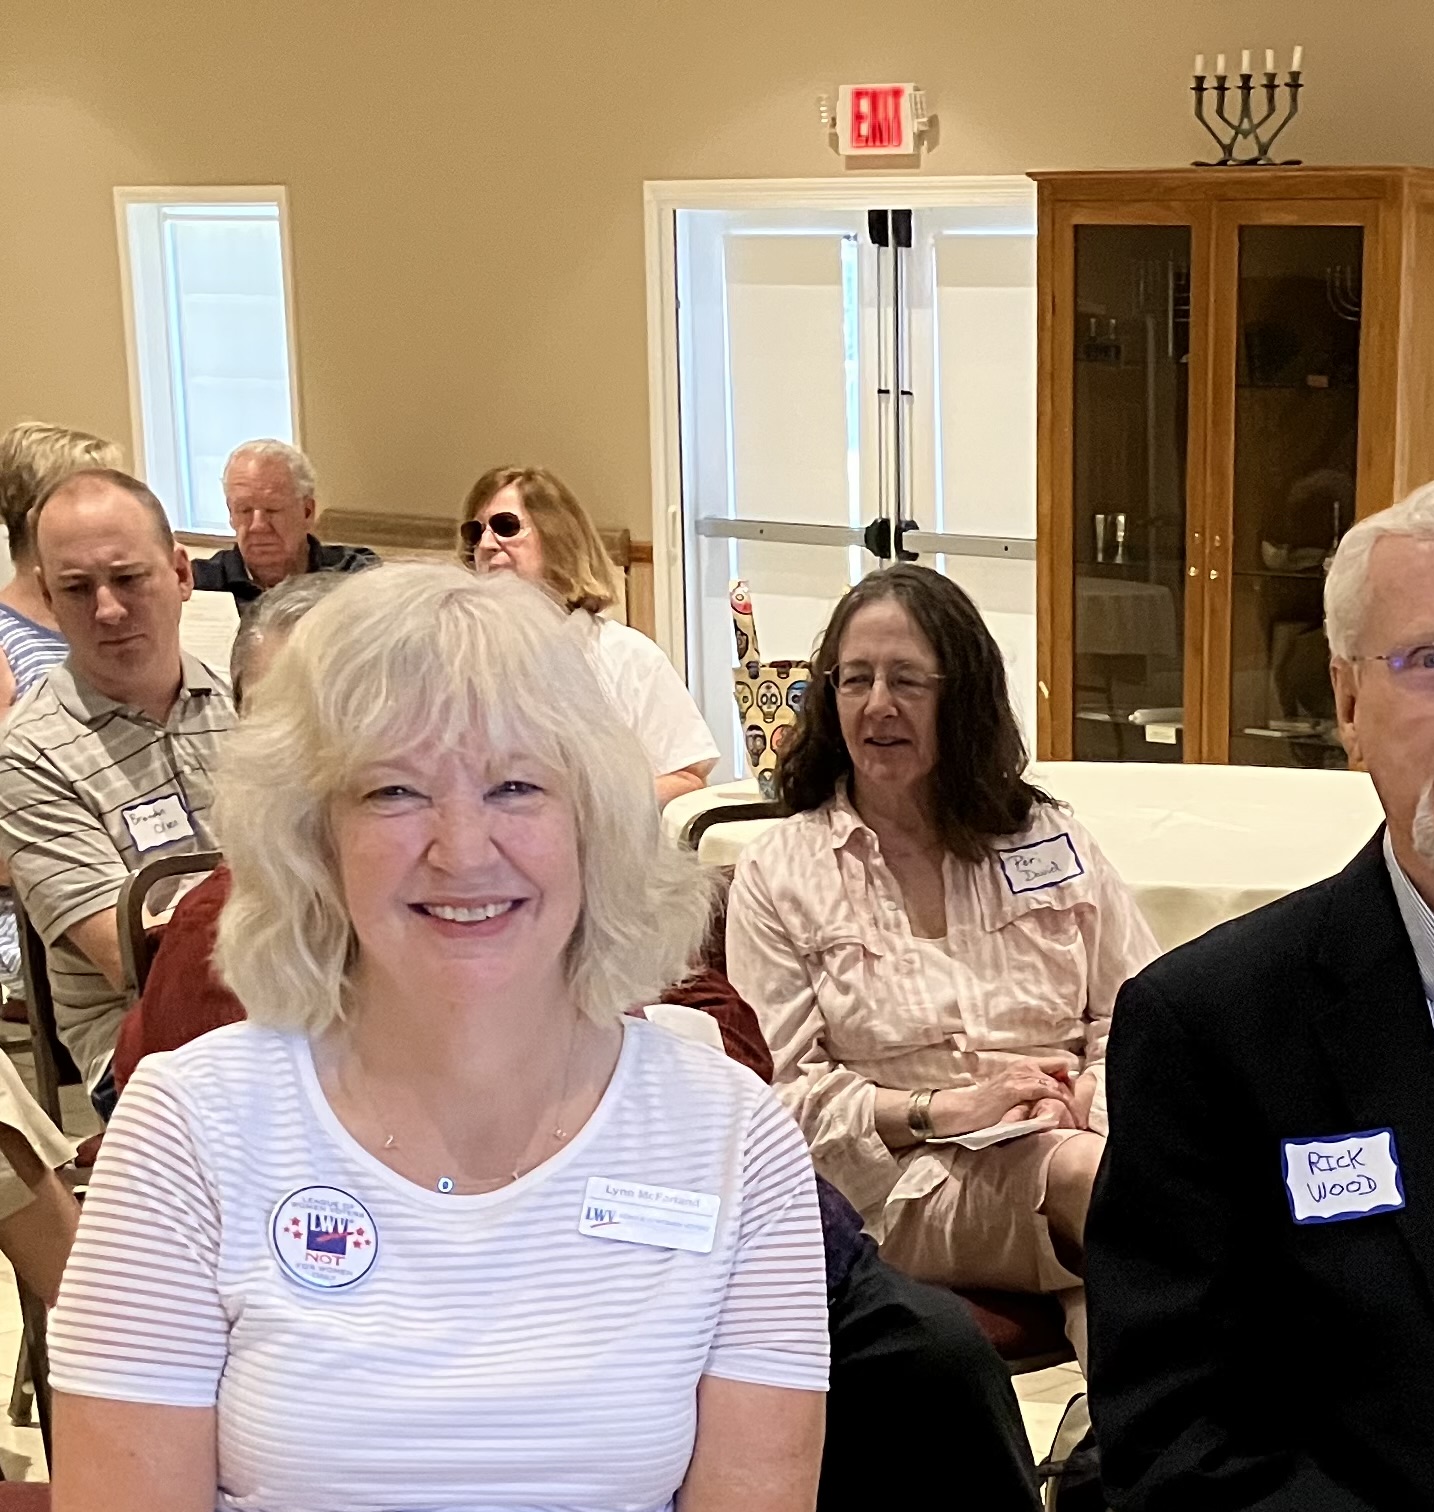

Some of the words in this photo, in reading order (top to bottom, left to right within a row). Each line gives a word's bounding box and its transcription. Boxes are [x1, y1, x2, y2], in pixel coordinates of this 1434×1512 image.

[852, 88, 903, 147] EXIT
[1307, 1147, 1366, 1176] RICK
[606, 1184, 635, 1198] Lynn
[1306, 1174, 1378, 1203] WOOD
[585, 1206, 616, 1223] LWV
[305, 1252, 346, 1266] NOT
